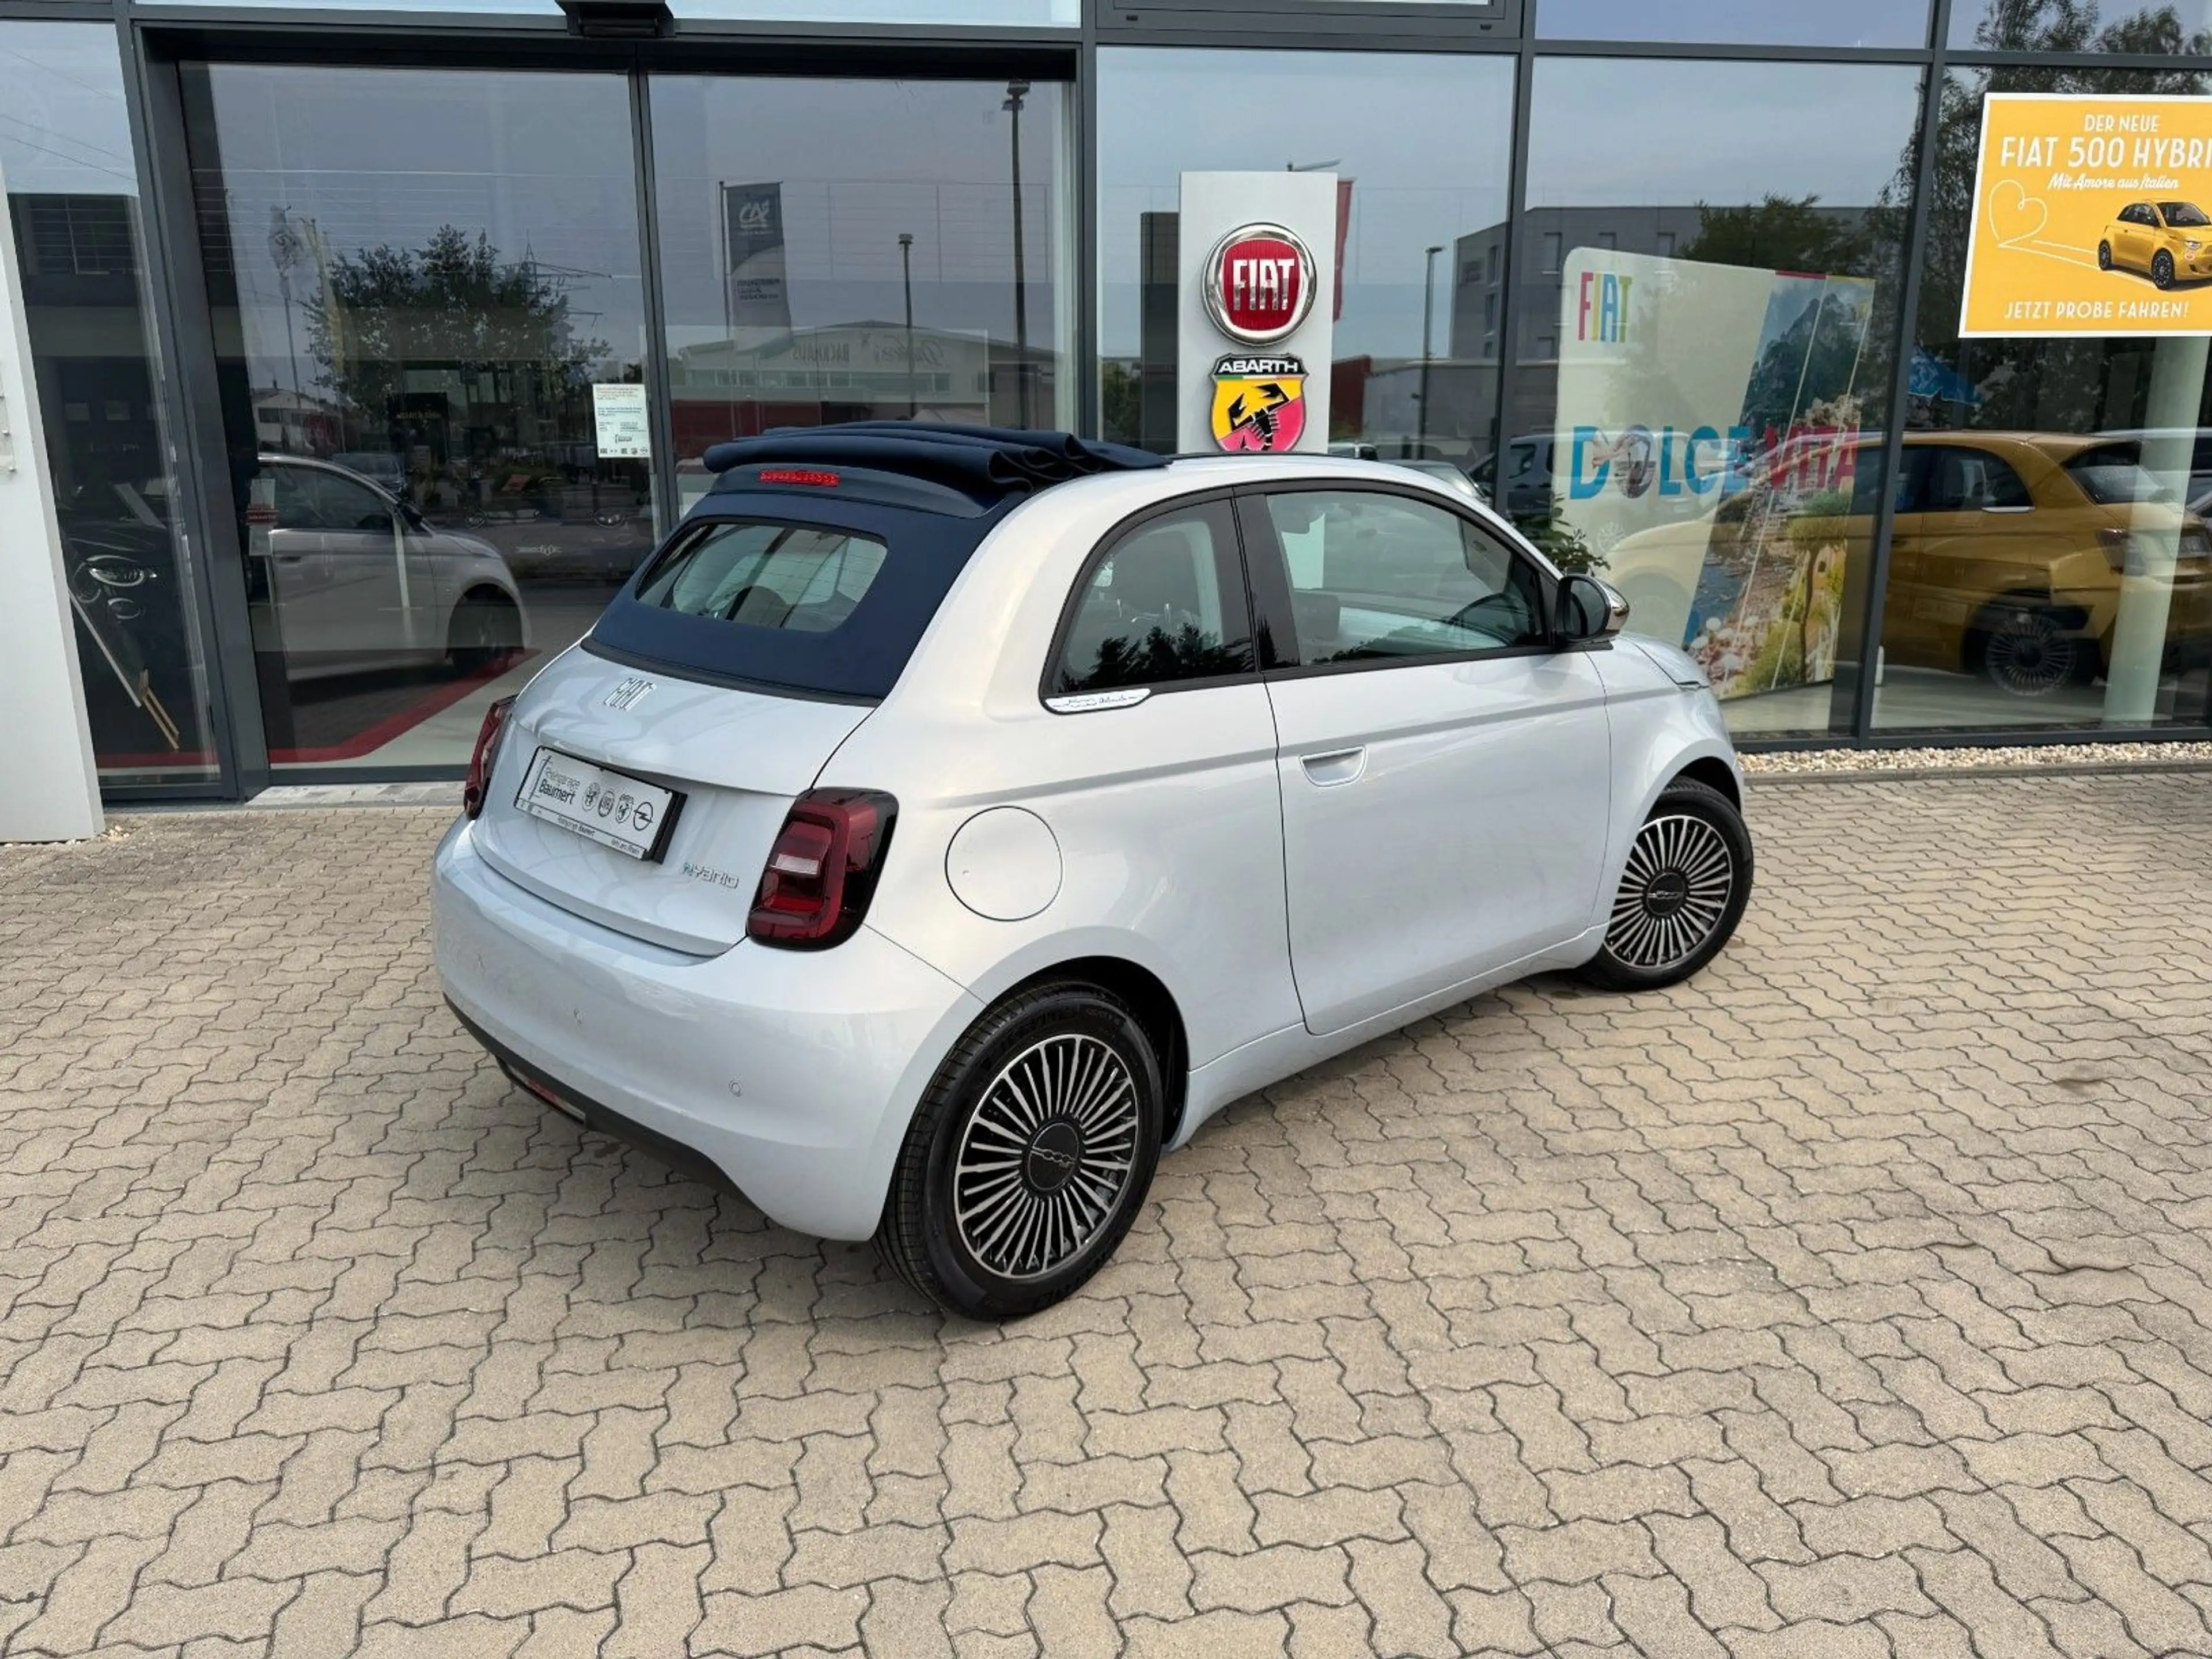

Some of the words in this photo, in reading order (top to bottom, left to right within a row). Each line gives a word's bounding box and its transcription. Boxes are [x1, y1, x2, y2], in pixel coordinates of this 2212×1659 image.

[2085, 115, 2113, 132] DER
[2119, 115, 2160, 133] NEUE
[2001, 137, 2058, 167] FIAT
[2068, 137, 2125, 168] 500
[2048, 172, 2072, 190] Mit
[2073, 172, 2115, 190] Amore
[2117, 178, 2139, 189] aus
[2138, 173, 2179, 190] Italien
[1233, 258, 1295, 310] FIAT
[1578, 272, 1632, 343] FIAT
[2004, 301, 2051, 319] JETZT
[2056, 301, 2112, 319] PROBE
[2118, 301, 2190, 319] FAHREN!
[1218, 359, 1298, 374] ABARTH
[1570, 423, 1751, 500] DOLCE
[1764, 425, 1860, 490] VITA
[604, 677, 657, 712] FIAT
[539, 778, 577, 805] Baumert
